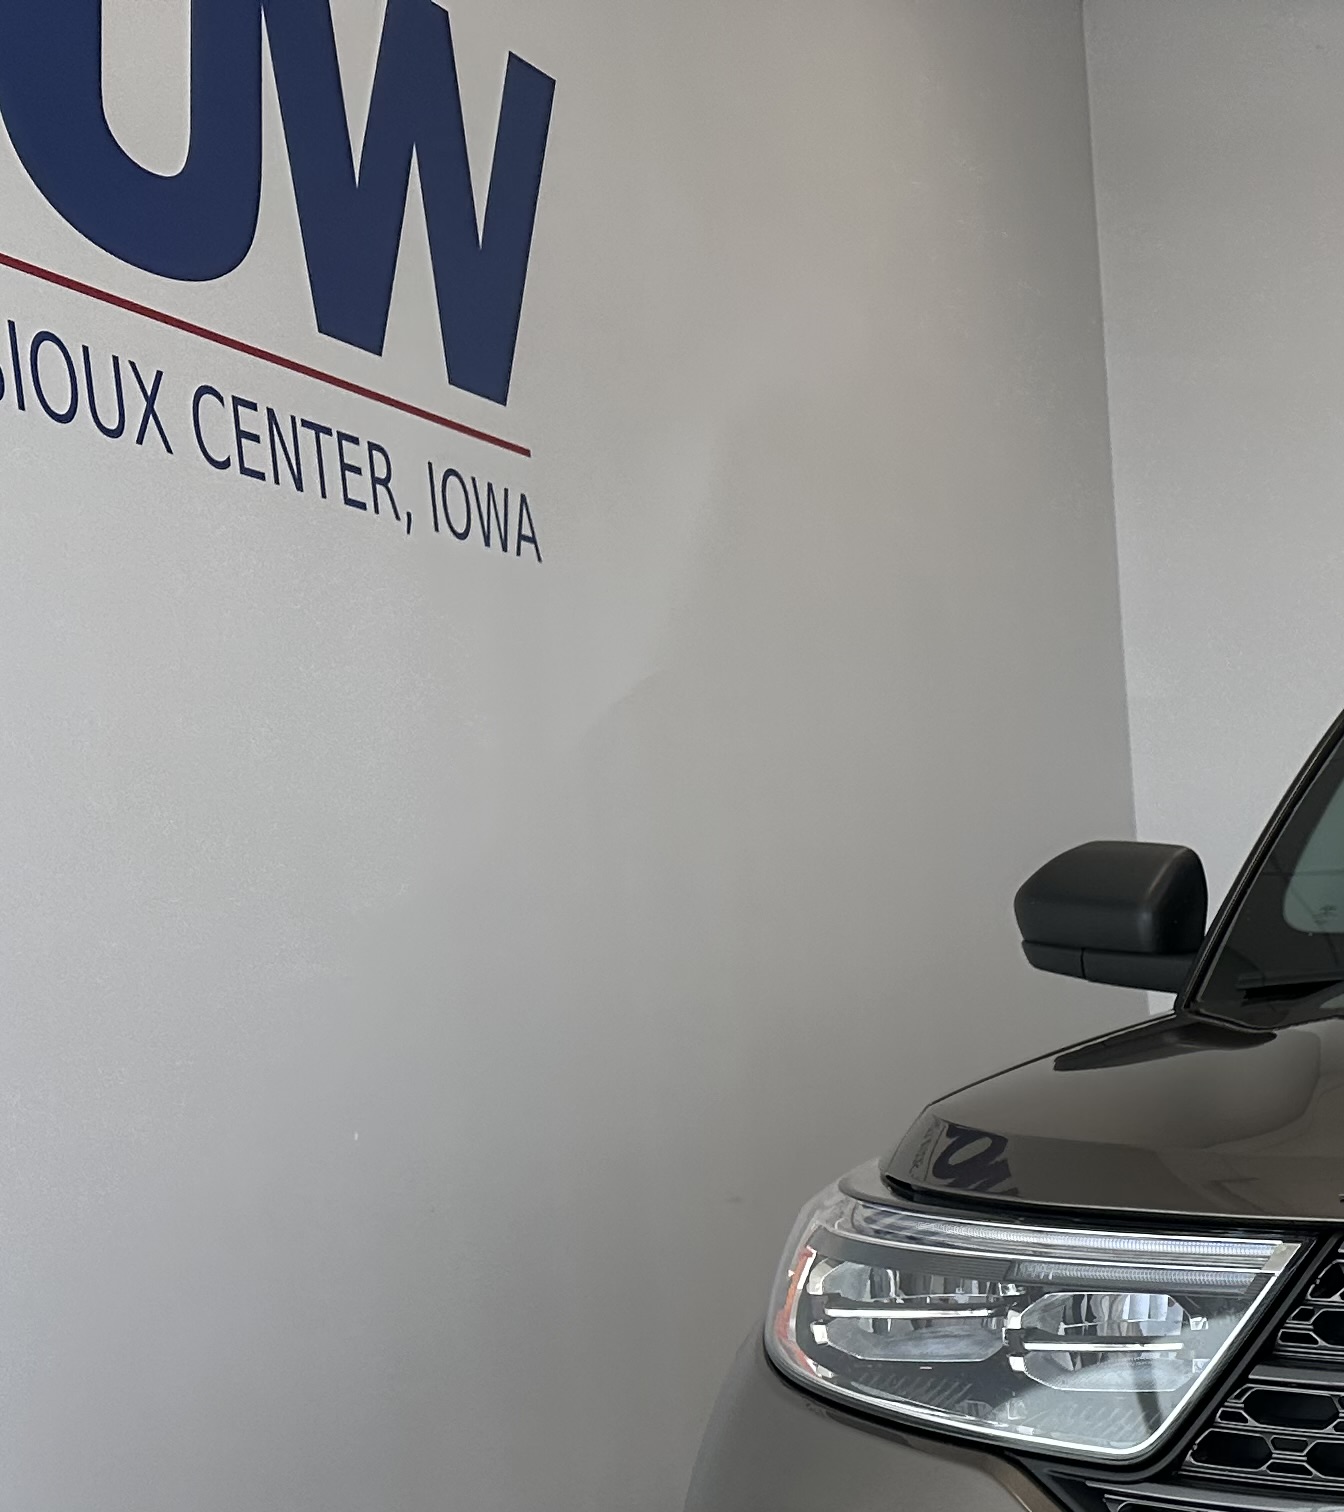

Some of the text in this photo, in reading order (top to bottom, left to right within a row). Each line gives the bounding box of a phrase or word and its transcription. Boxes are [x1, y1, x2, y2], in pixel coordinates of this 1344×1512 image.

[0, 319, 543, 563] IOUX CENTER, IOWA
